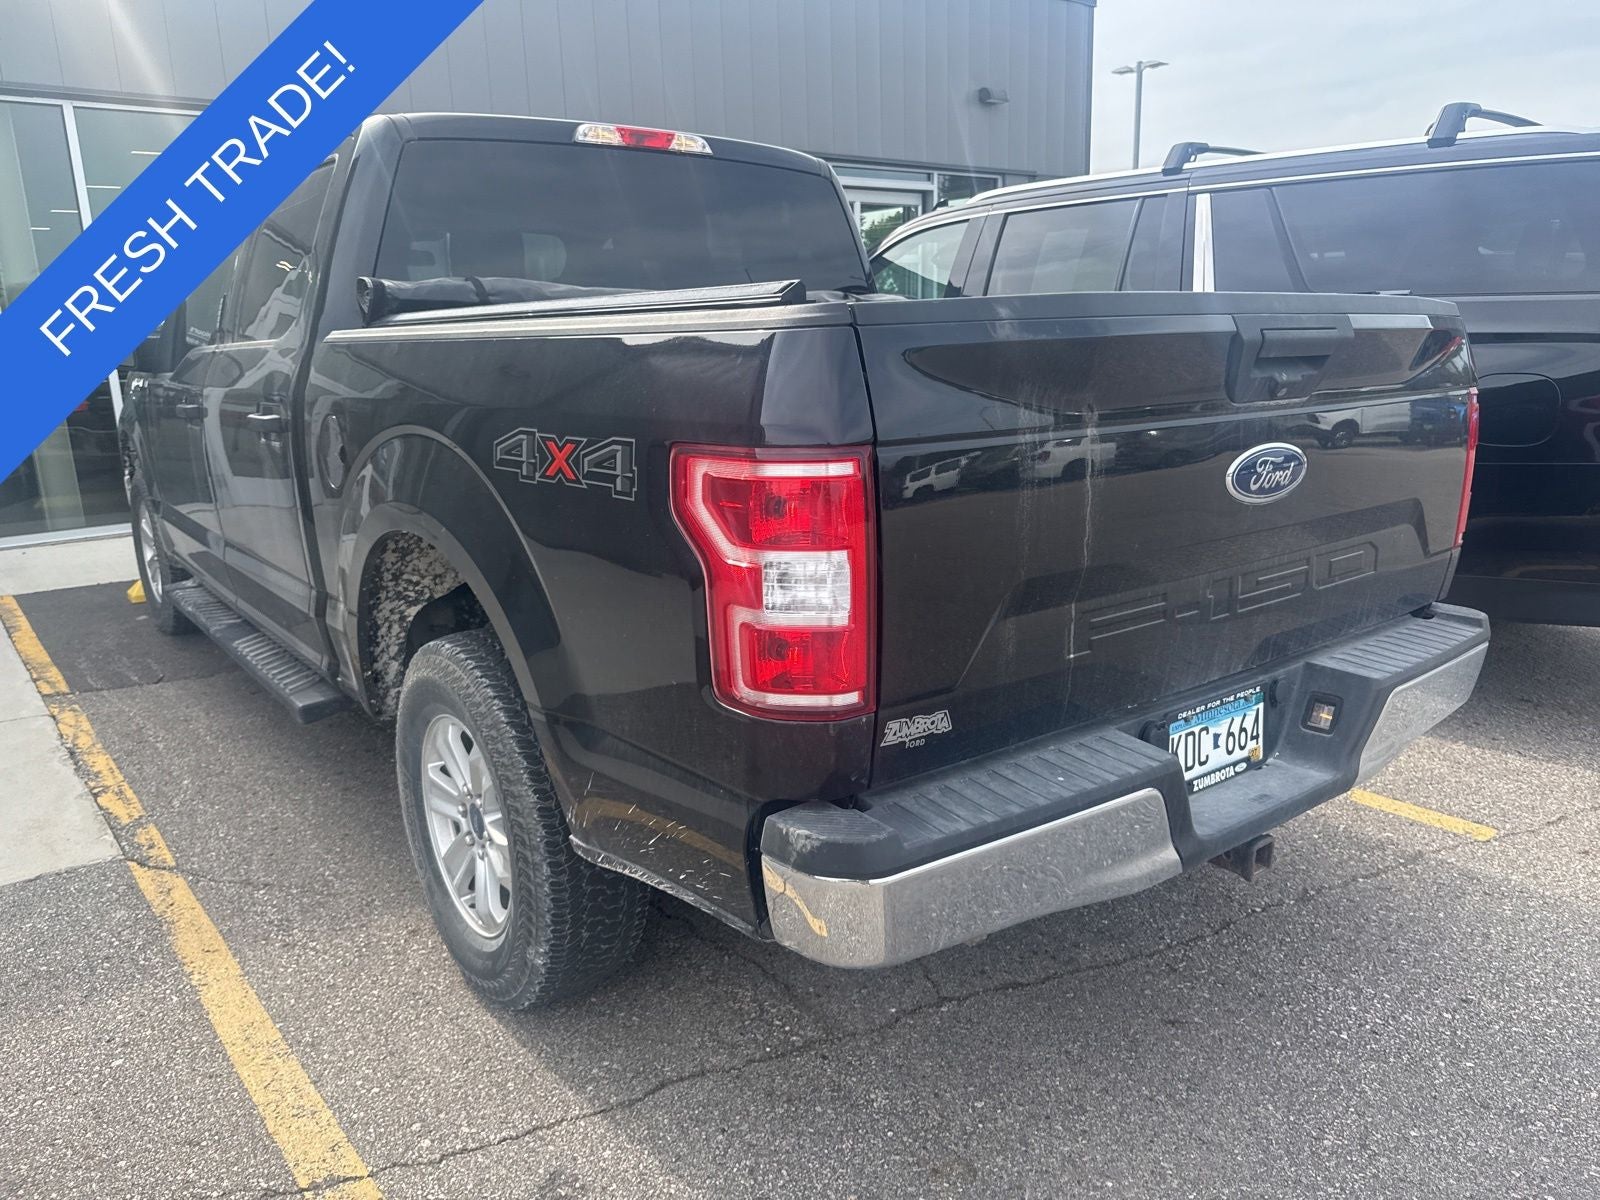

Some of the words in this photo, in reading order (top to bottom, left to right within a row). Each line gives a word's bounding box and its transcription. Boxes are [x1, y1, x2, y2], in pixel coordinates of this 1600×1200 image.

[1250, 456, 1297, 491] Ford
[1066, 541, 1378, 660] F-150
[1177, 705, 1206, 720] DEALER
[1207, 700, 1221, 709] FOR
[1222, 694, 1235, 704] THE
[1236, 686, 1261, 699] PEOPLE
[1193, 700, 1241, 724] Minnesota
[882, 710, 951, 745] ZUMBROTA
[905, 738, 926, 749] FORD
[1170, 725, 1210, 773] KDC
[1225, 707, 1260, 756] 664
[1192, 765, 1236, 792] ZUMBROTA
